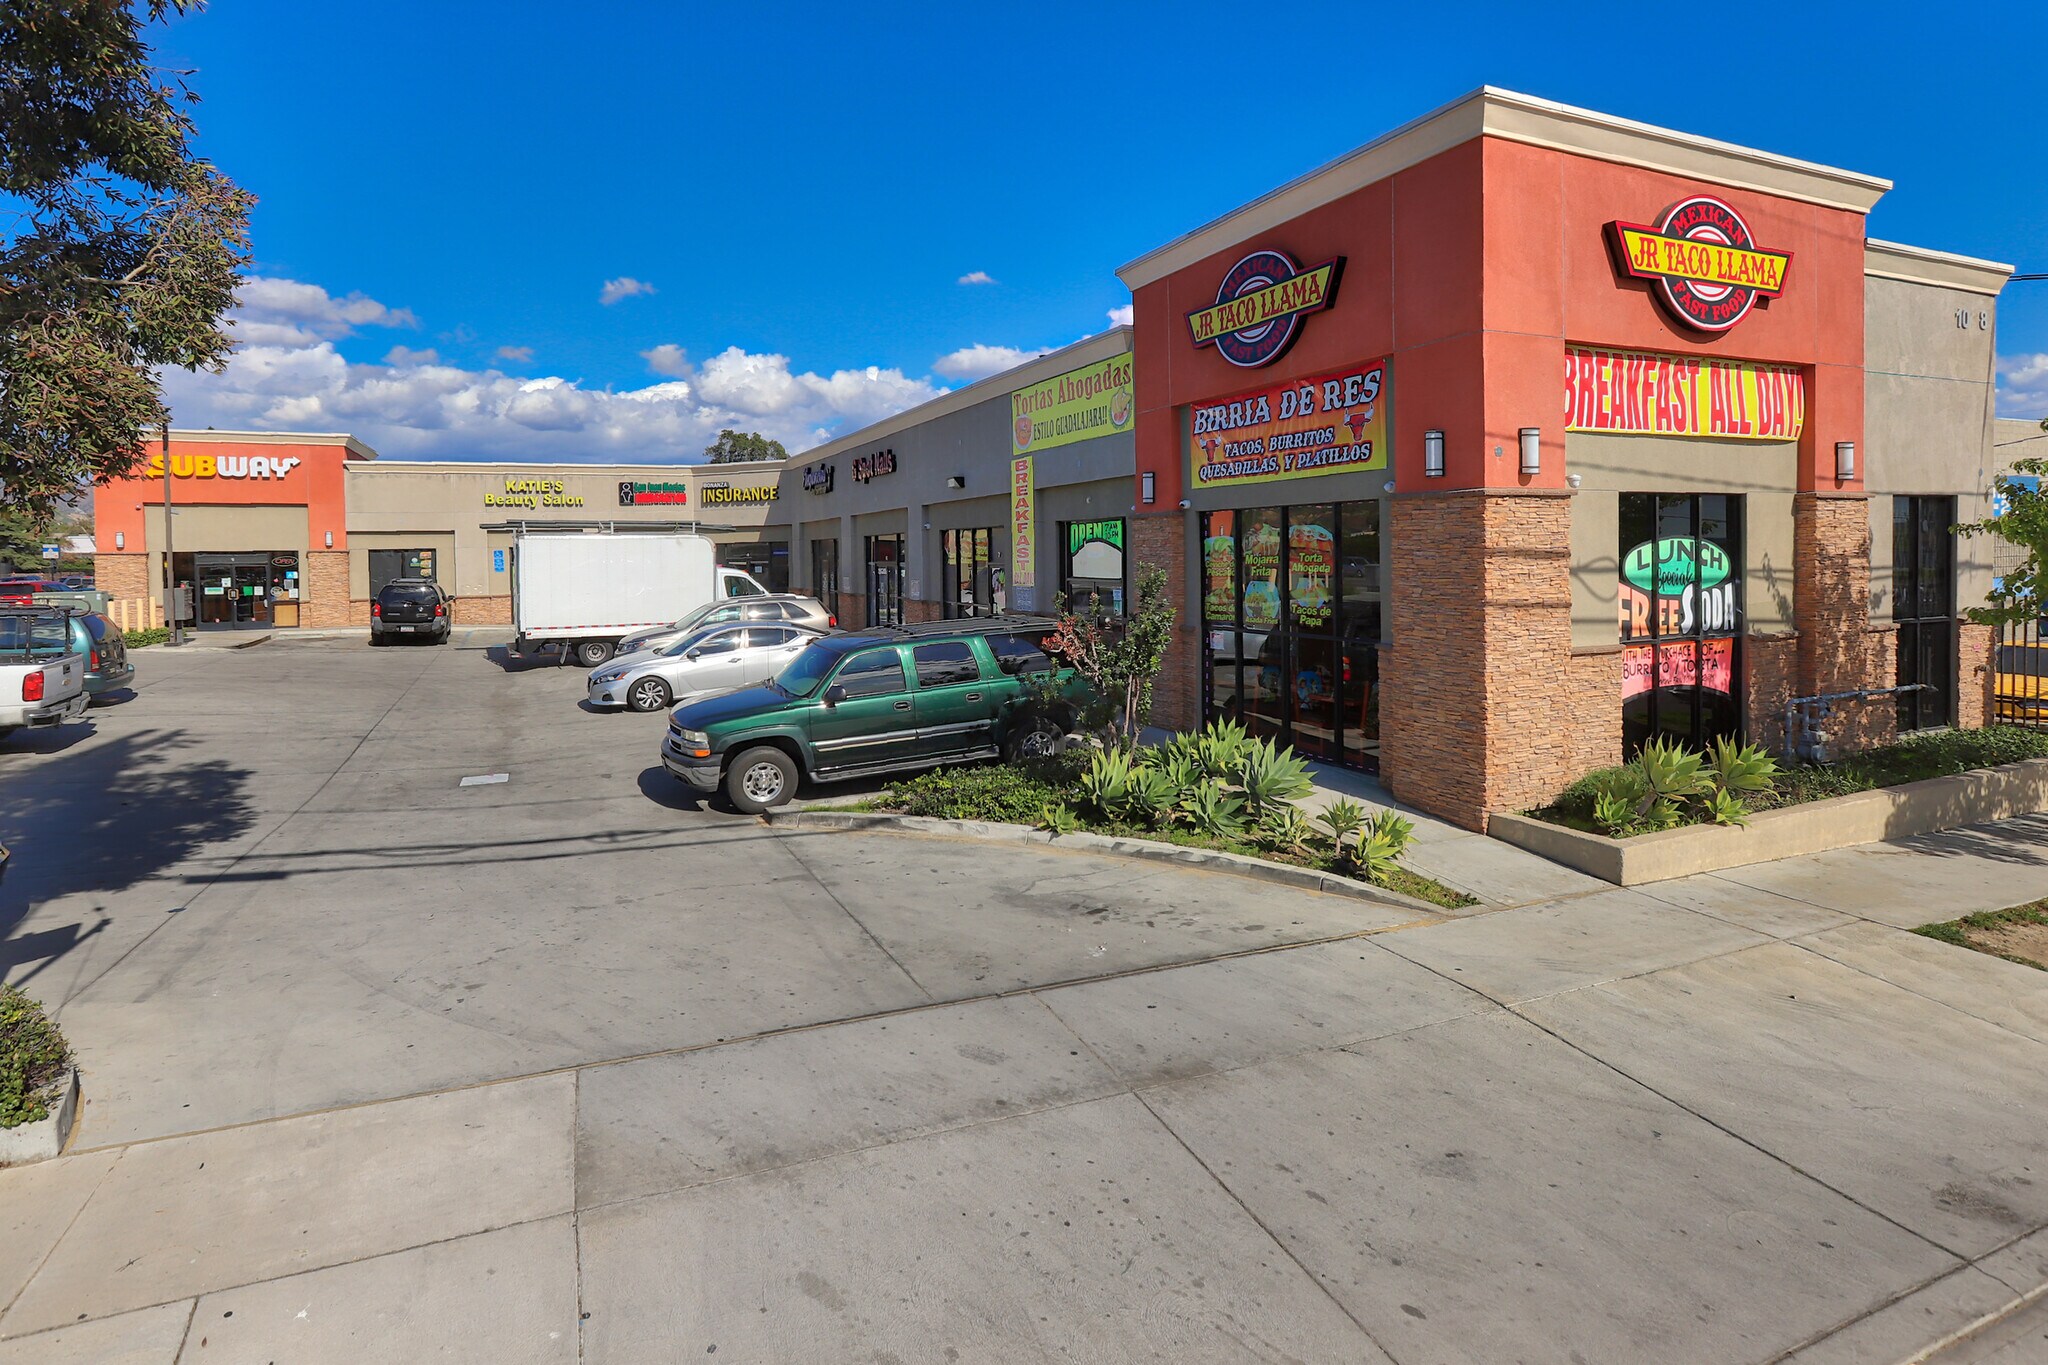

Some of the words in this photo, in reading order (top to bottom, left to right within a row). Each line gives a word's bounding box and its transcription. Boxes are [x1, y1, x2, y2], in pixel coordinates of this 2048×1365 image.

[1672, 204, 1746, 246] MEXICAN
[1224, 256, 1288, 298] MEXICAN
[1634, 236, 1660, 268] JR
[1664, 241, 1711, 277] TACO
[1717, 250, 1779, 288] LLAMA
[1196, 311, 1214, 340] JR
[1218, 297, 1257, 331] TACO
[1261, 273, 1321, 319] LLAMA
[1673, 280, 1708, 320] FAST
[1713, 288, 1747, 321] FOOD
[1223, 335, 1251, 360] FAST
[1256, 319, 1287, 358] FOOD
[1013, 391, 1054, 417] Tortas
[1058, 362, 1132, 405] Ahogadas
[1194, 396, 1271, 435] BIRRIA
[1279, 386, 1315, 420] DE
[1323, 369, 1382, 412] RES
[1565, 348, 1701, 433] BREAKFAST
[1708, 361, 1752, 435] ALL
[1755, 364, 1803, 438] DAY!
[1033, 418, 1055, 441] ESTILO
[1056, 405, 1108, 436] GUADALAJARA!!
[1224, 438, 1265, 458] TACOS,
[1268, 427, 1335, 452] BURRITOS,
[145, 454, 300, 478] SUBWAY
[1199, 456, 1279, 481] QUESADILLAS,
[1284, 454, 1297, 470] Y
[1297, 443, 1371, 468] PLATILLOS
[484, 493, 538, 508] Beauty
[543, 494, 584, 506] Salon
[505, 480, 563, 492] KATIE'S
[703, 486, 778, 503] INSURANCE
[1014, 459, 1030, 571] BREAKFAST
[1071, 522, 1103, 554] OPEN
[1245, 554, 1279, 566] Mojarra
[1251, 566, 1271, 577] Frita
[1292, 563, 1331, 575] Ahogada
[1299, 553, 1322, 563] Torta
[1637, 540, 1722, 571] LUNCH
[1291, 604, 1318, 616] Tacos
[1319, 606, 1332, 616] de
[1299, 615, 1322, 627] Papa
[1618, 582, 1680, 637] FREE
[1681, 583, 1734, 634] SODA
[1639, 646, 1651, 659] THE
